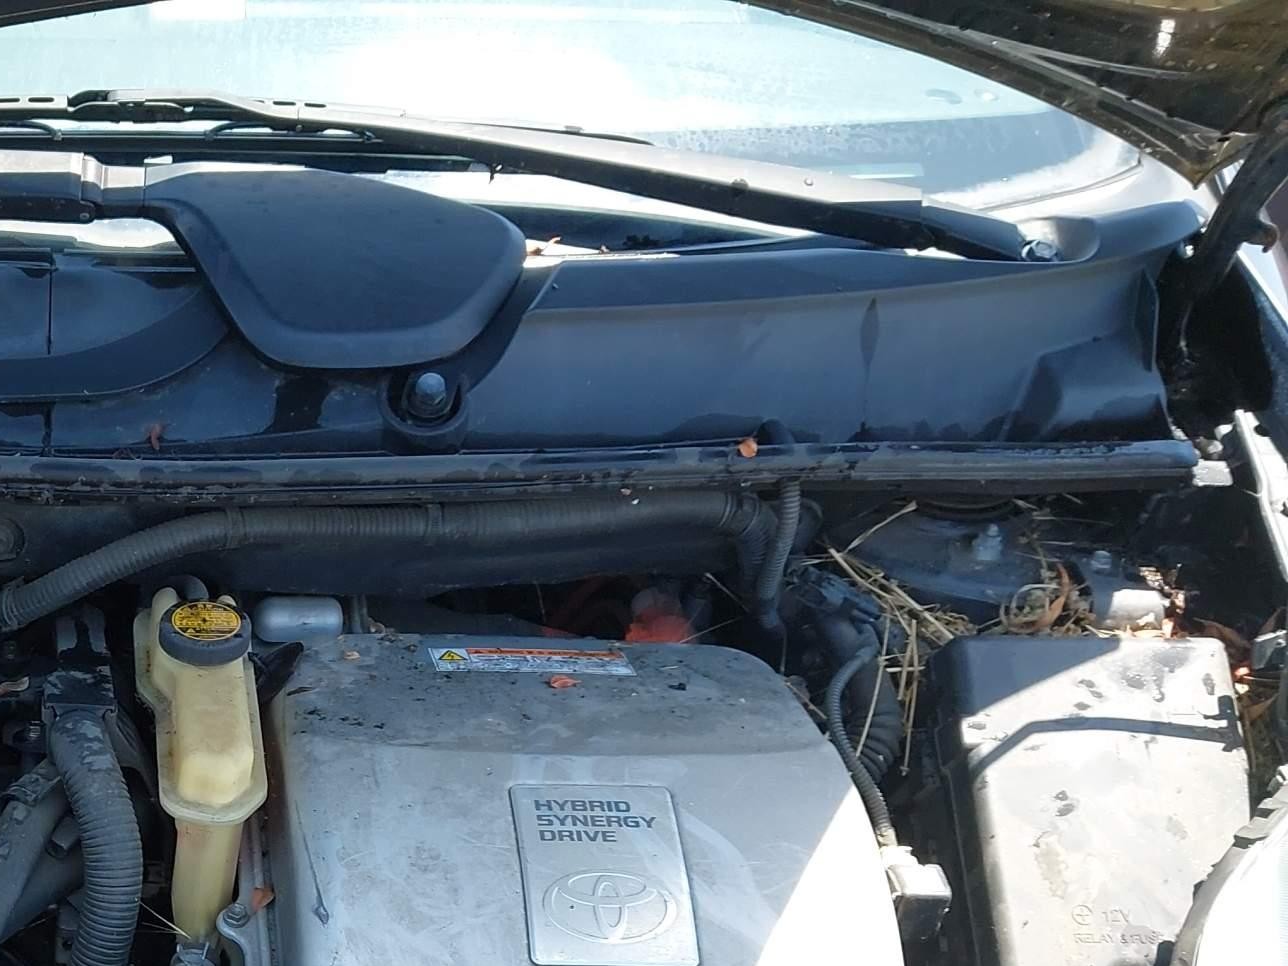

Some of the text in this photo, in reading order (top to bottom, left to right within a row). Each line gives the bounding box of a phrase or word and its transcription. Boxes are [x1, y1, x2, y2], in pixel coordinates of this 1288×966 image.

[533, 799, 631, 813] HYBRID
[535, 814, 657, 828] SYNERGY
[539, 829, 617, 842] DRIVE
